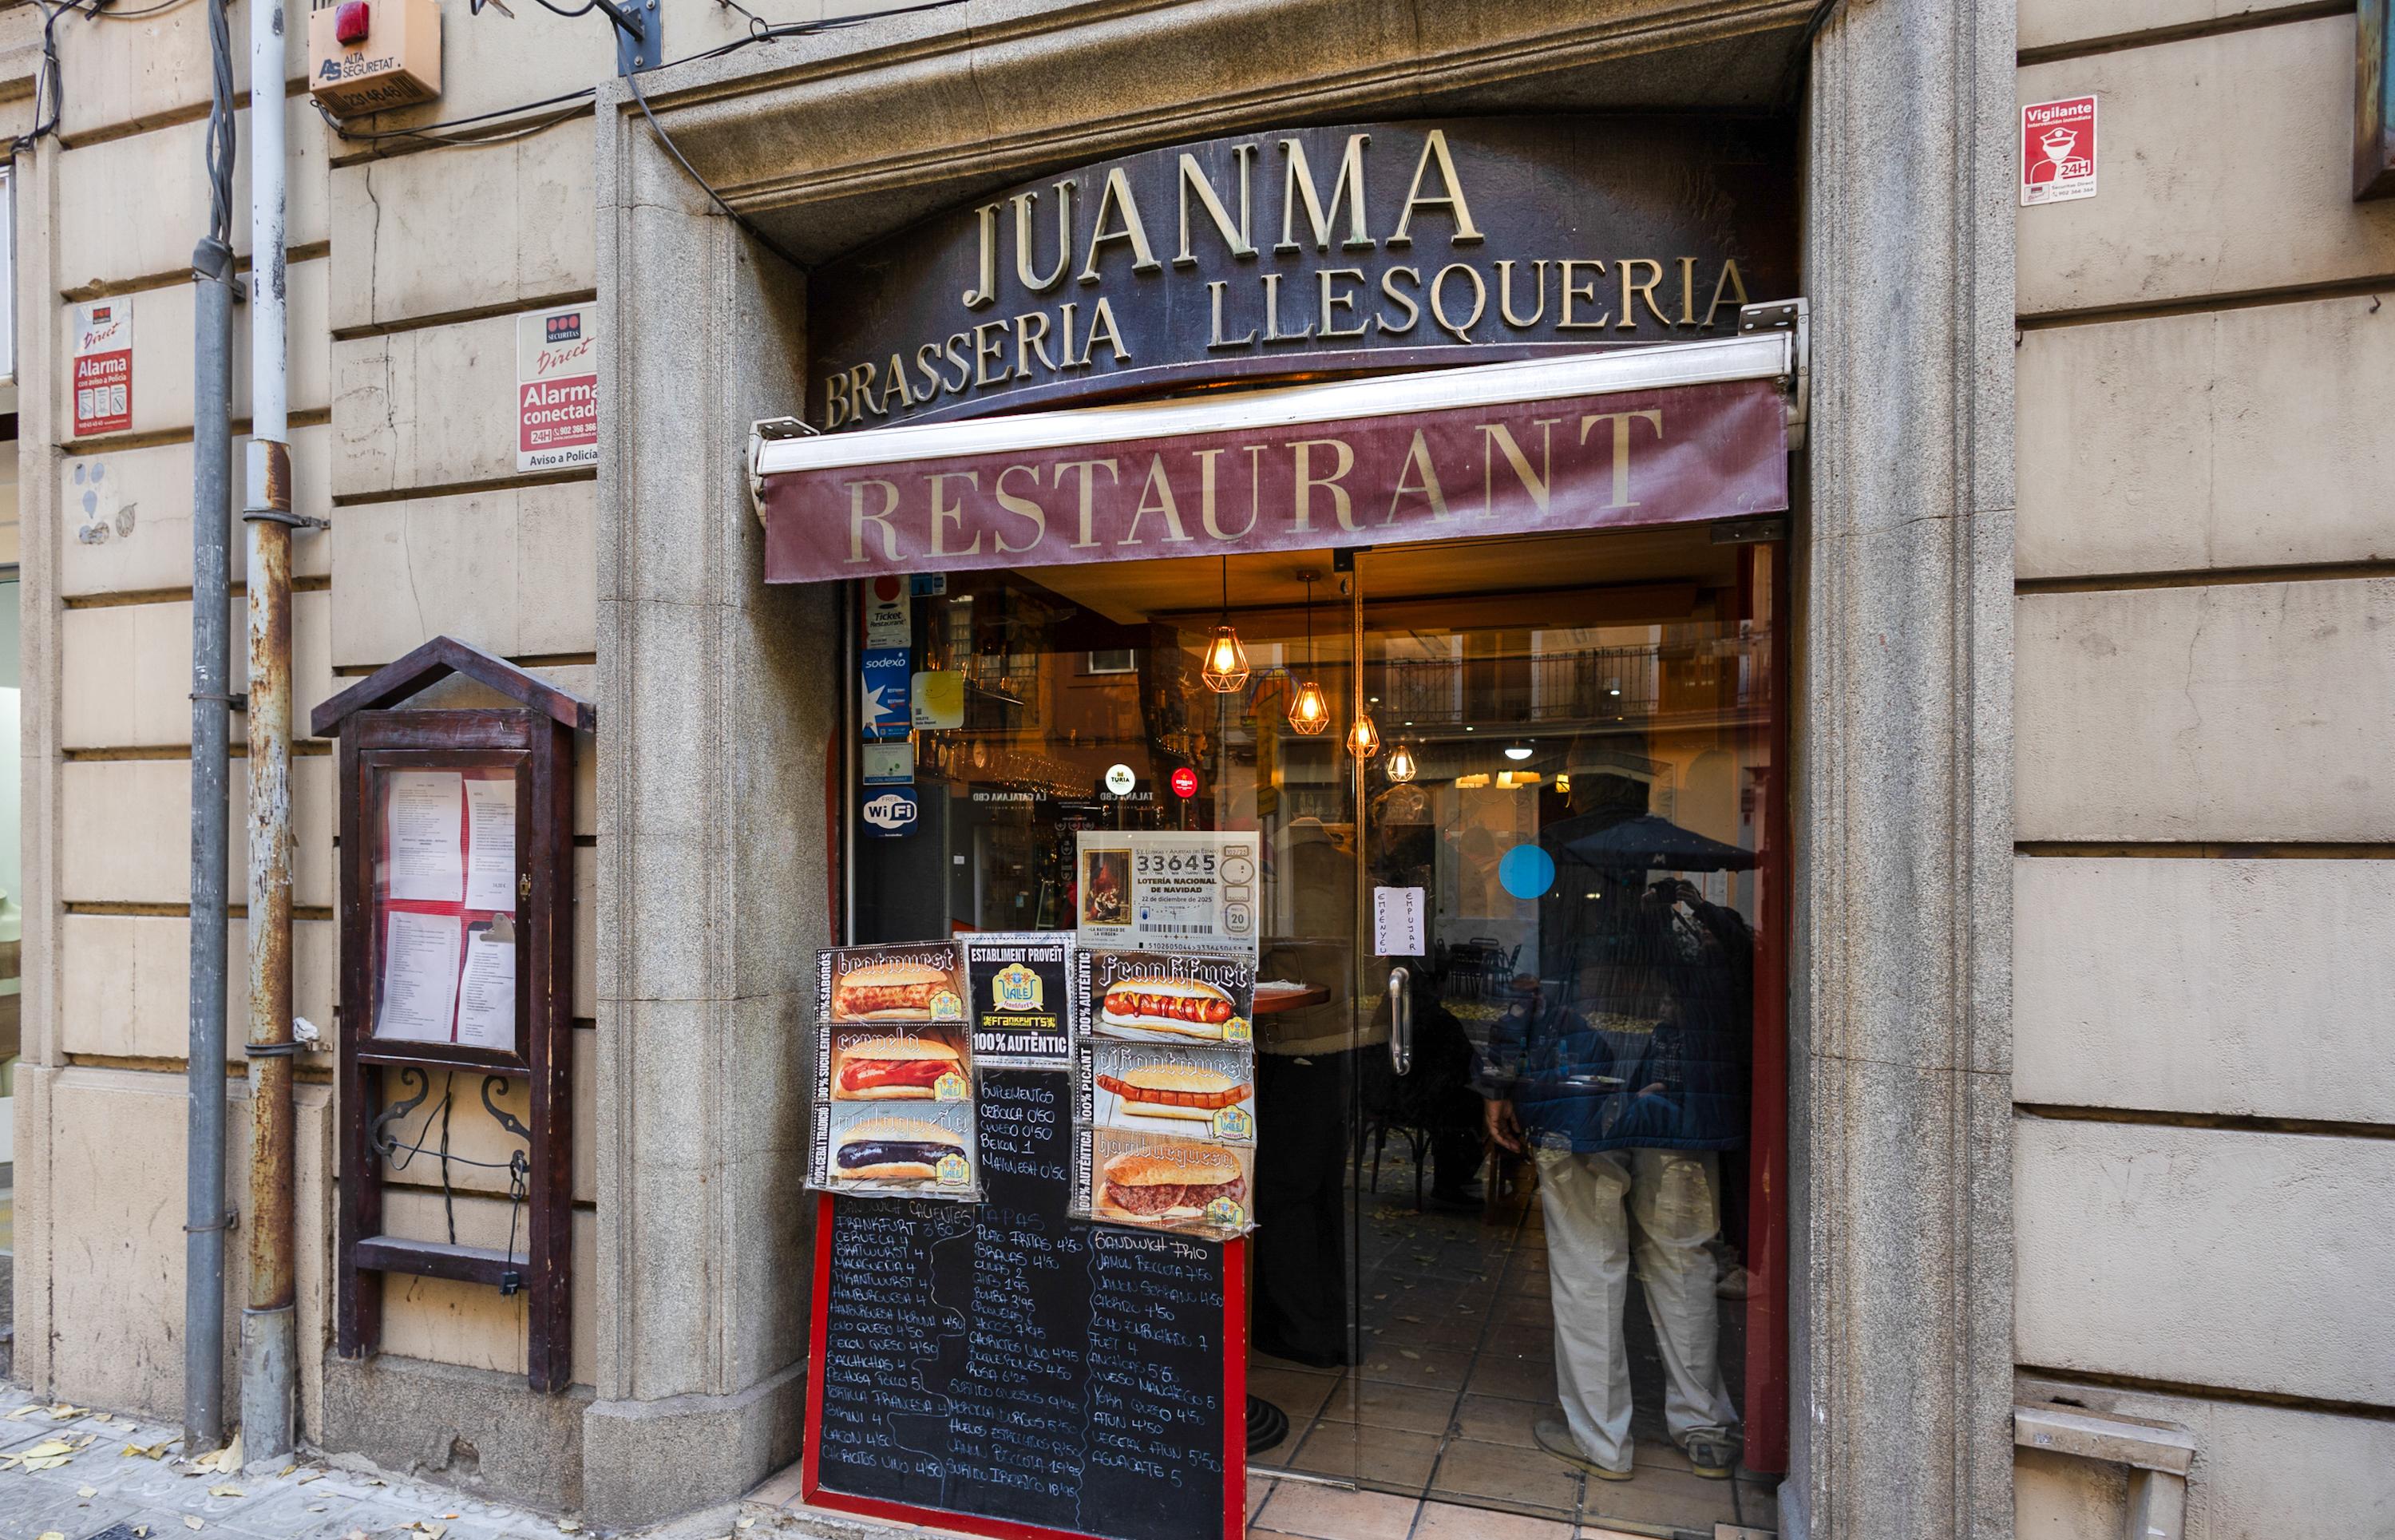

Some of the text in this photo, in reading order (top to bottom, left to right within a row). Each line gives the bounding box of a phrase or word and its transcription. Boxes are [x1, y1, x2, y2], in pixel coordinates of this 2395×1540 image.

[343, 57, 394, 78] SEGURETAT
[344, 52, 365, 66] ALTA
[2028, 104, 2092, 121] Vigilante
[2060, 162, 2088, 176] 24H
[962, 129, 1484, 311] JUANMA
[548, 331, 580, 340] SECURITAS
[825, 257, 1750, 433] BRASSERIA LLESQUERIA
[536, 337, 596, 374] Direct
[78, 358, 126, 378] Alarma
[524, 400, 597, 425] conectad
[532, 430, 551, 442] 24H
[530, 454, 556, 466] Aviso
[566, 449, 598, 462] Policía
[843, 408, 1663, 565] RESTAURANT
[874, 612, 903, 621] Ticket
[865, 657, 906, 669] sodexo
[1231, 914, 1244, 924] 20
[1378, 893, 1387, 953] EMPENYEU
[1406, 893, 1416, 951] EMPUJAR
[837, 948, 954, 976] bratwurst
[971, 945, 1063, 962] ESTABLIMENT PROVEÏT
[1078, 952, 1091, 1035] 100% AUTÈNTIC
[838, 1027, 920, 1053] cervela
[973, 1031, 1067, 1054] 100% AUTÈNTIC
[818, 1027, 831, 1078] SUCULENTA
[1096, 1045, 1252, 1081] pikantwurst
[1081, 1047, 1092, 1121] 100% PICANT
[817, 1107, 829, 1138] TRADICIÓ
[1022, 1126, 1053, 1140] 0'50
[816, 1142, 828, 1164] CEBA
[1098, 1132, 1234, 1169] hamburguesa
[814, 1164, 827, 1185] 100%
[976, 1203, 1045, 1231] TAPAS
[837, 1216, 953, 1237] FRANKFURT 3'50
[901, 1237, 909, 1247] 4
[915, 1249, 924, 1259] 4
[907, 1263, 916, 1274] 4
[1015, 1267, 1026, 1279] 2
[919, 1279, 927, 1289] 4
[916, 1295, 926, 1307] 4
[857, 1323, 893, 1336] QUESO
[1128, 1341, 1138, 1356] 4
[898, 1360, 906, 1370] 4
[911, 1376, 920, 1391] 5
[873, 1413, 881, 1425] 4
[1093, 1411, 1126, 1428] ATUN
[1170, 1470, 1182, 1488] 5
